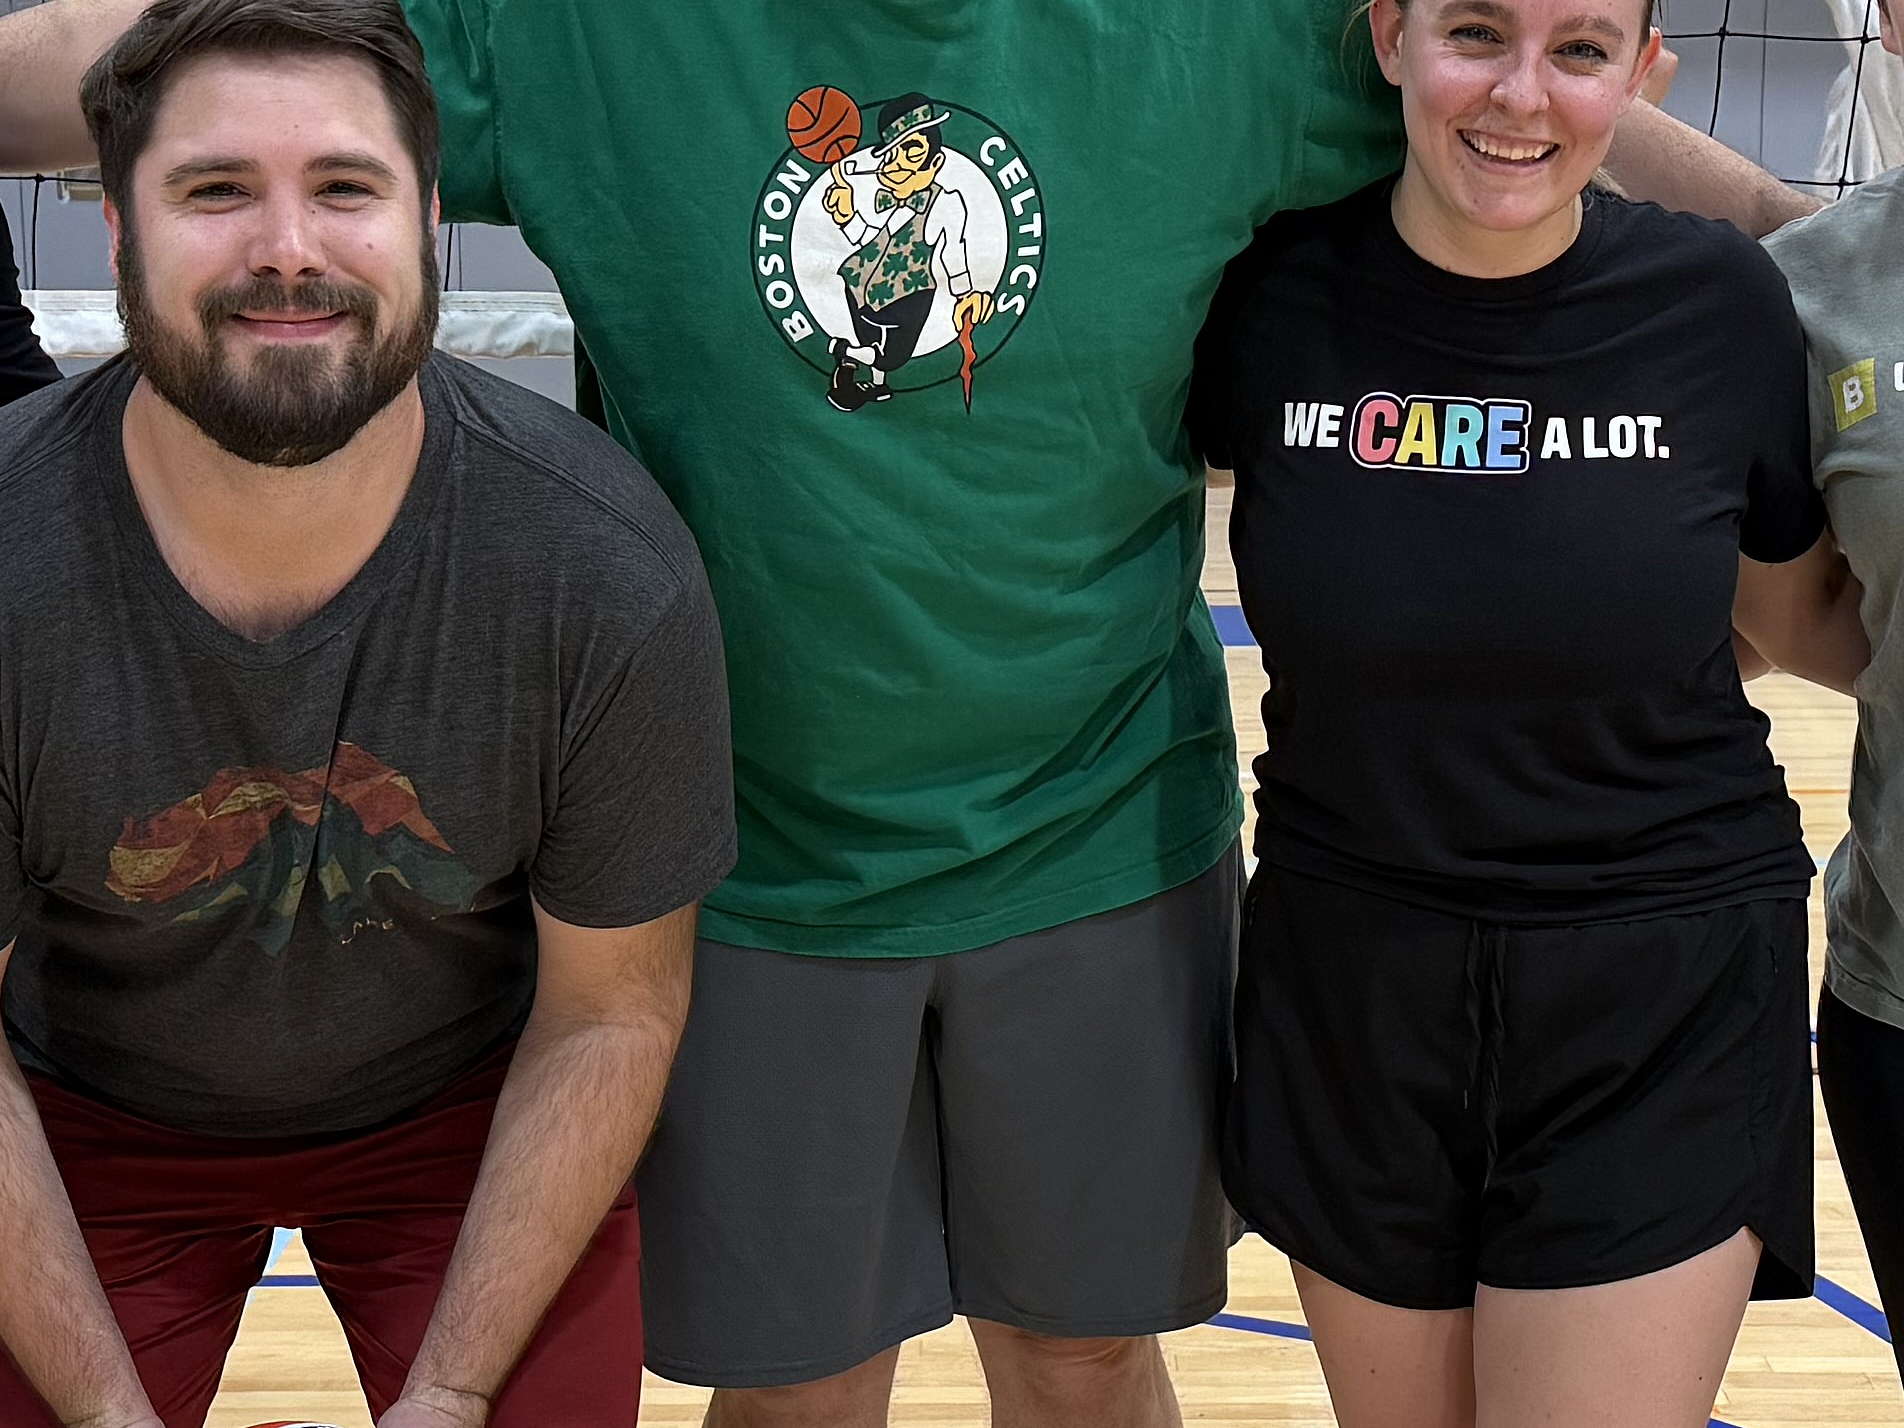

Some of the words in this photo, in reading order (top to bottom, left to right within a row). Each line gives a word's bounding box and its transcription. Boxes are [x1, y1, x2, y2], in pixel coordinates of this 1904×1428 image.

[758, 158, 814, 343] BOSTON
[980, 135, 1042, 317] CELTICS
[1284, 402, 1344, 448] WE
[1353, 396, 1528, 471] CARE
[1540, 417, 1571, 459] A
[1582, 415, 1670, 459] LOT.
